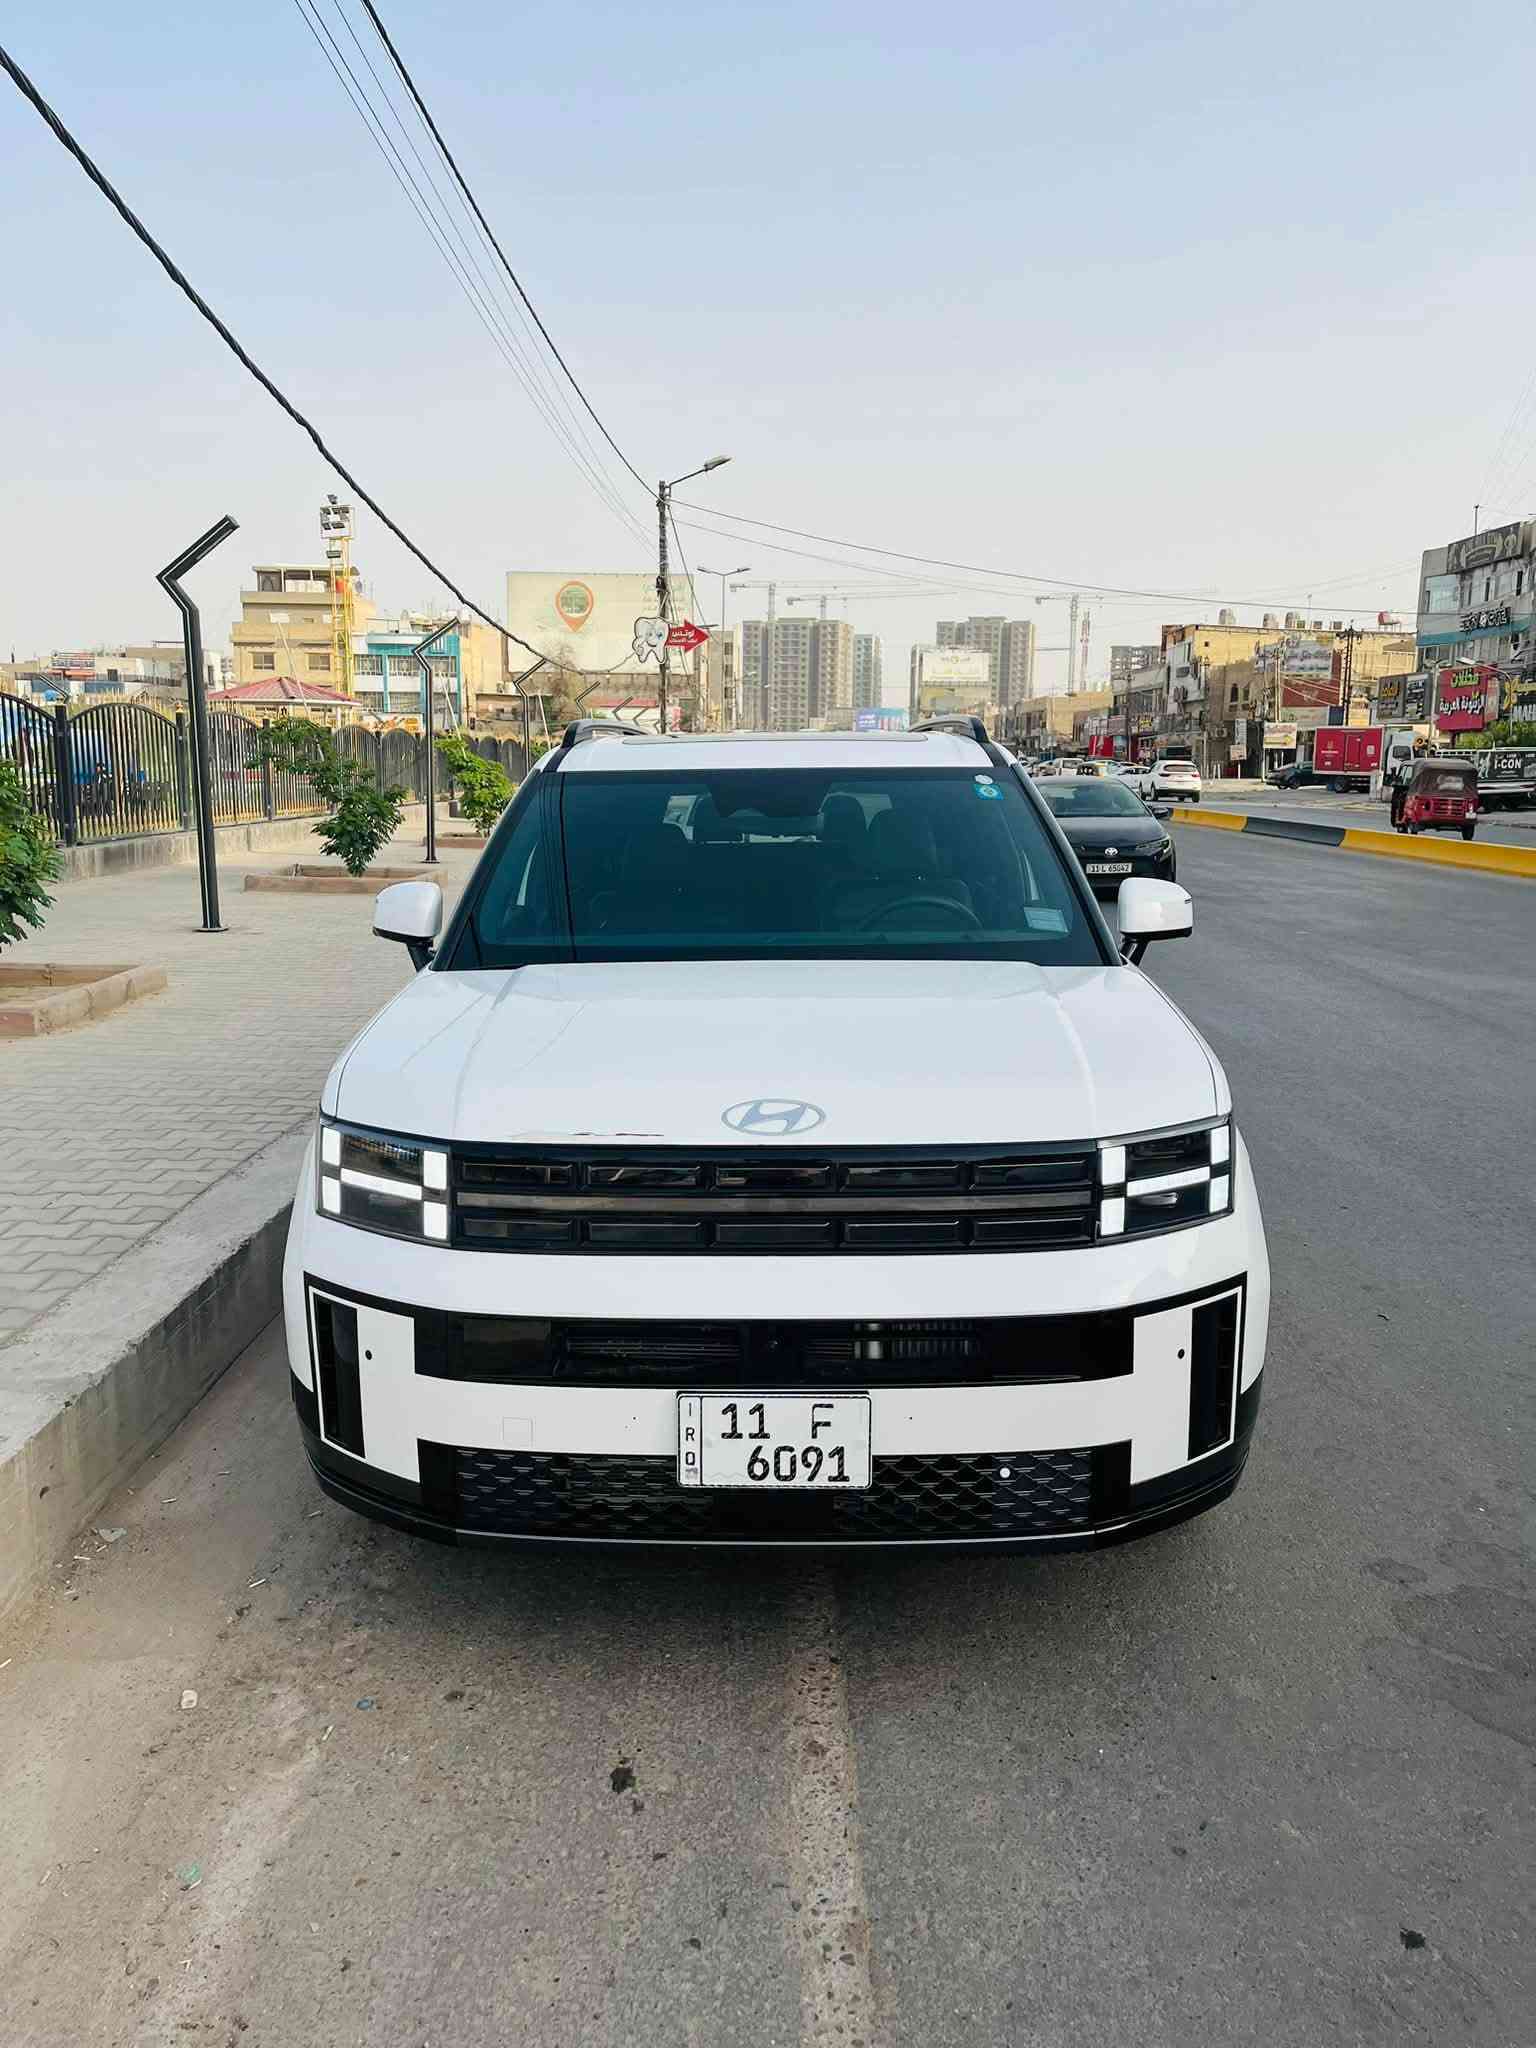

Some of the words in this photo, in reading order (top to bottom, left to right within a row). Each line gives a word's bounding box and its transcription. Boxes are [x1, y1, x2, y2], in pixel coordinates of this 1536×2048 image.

[721, 1403, 770, 1439] 11
[811, 1403, 834, 1439] F
[747, 1445, 850, 1482] 6091
